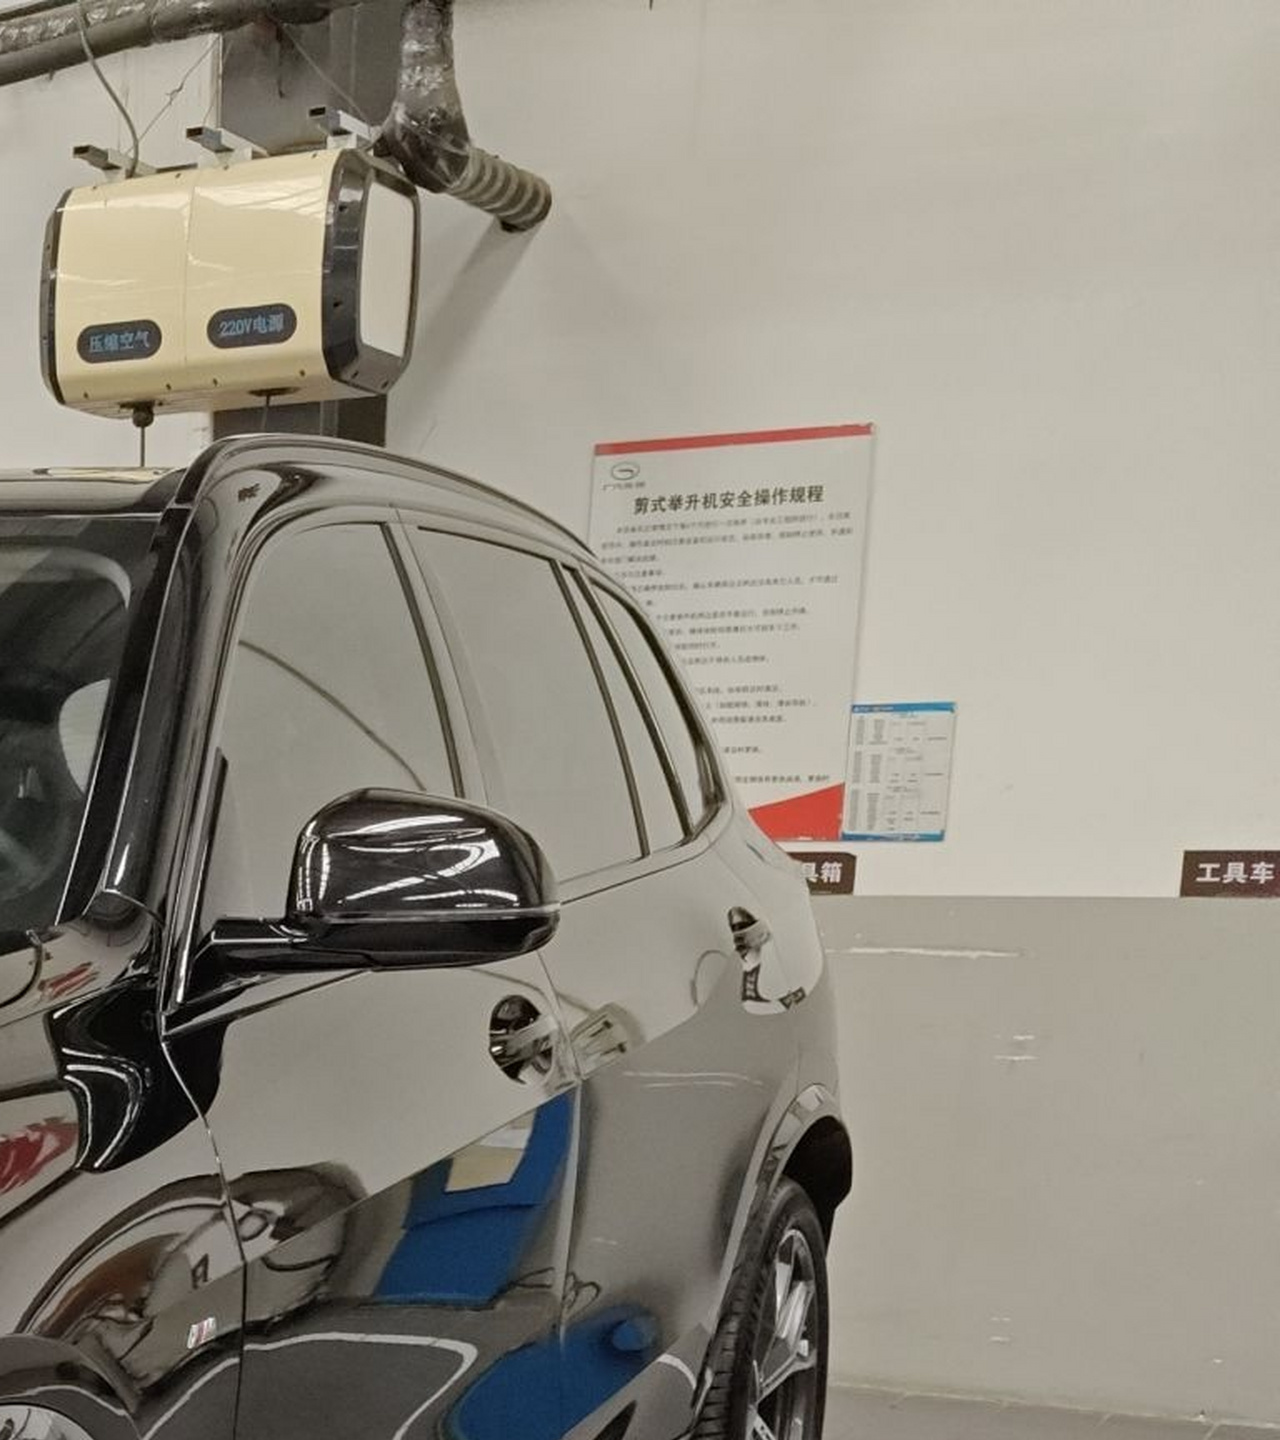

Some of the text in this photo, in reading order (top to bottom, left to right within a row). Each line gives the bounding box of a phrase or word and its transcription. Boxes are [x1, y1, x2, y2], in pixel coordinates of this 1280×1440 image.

[633, 485, 825, 516] 剪式举升机安全操作规程
[801, 861, 843, 884] 具箱
[1195, 861, 1275, 884] 工具车
